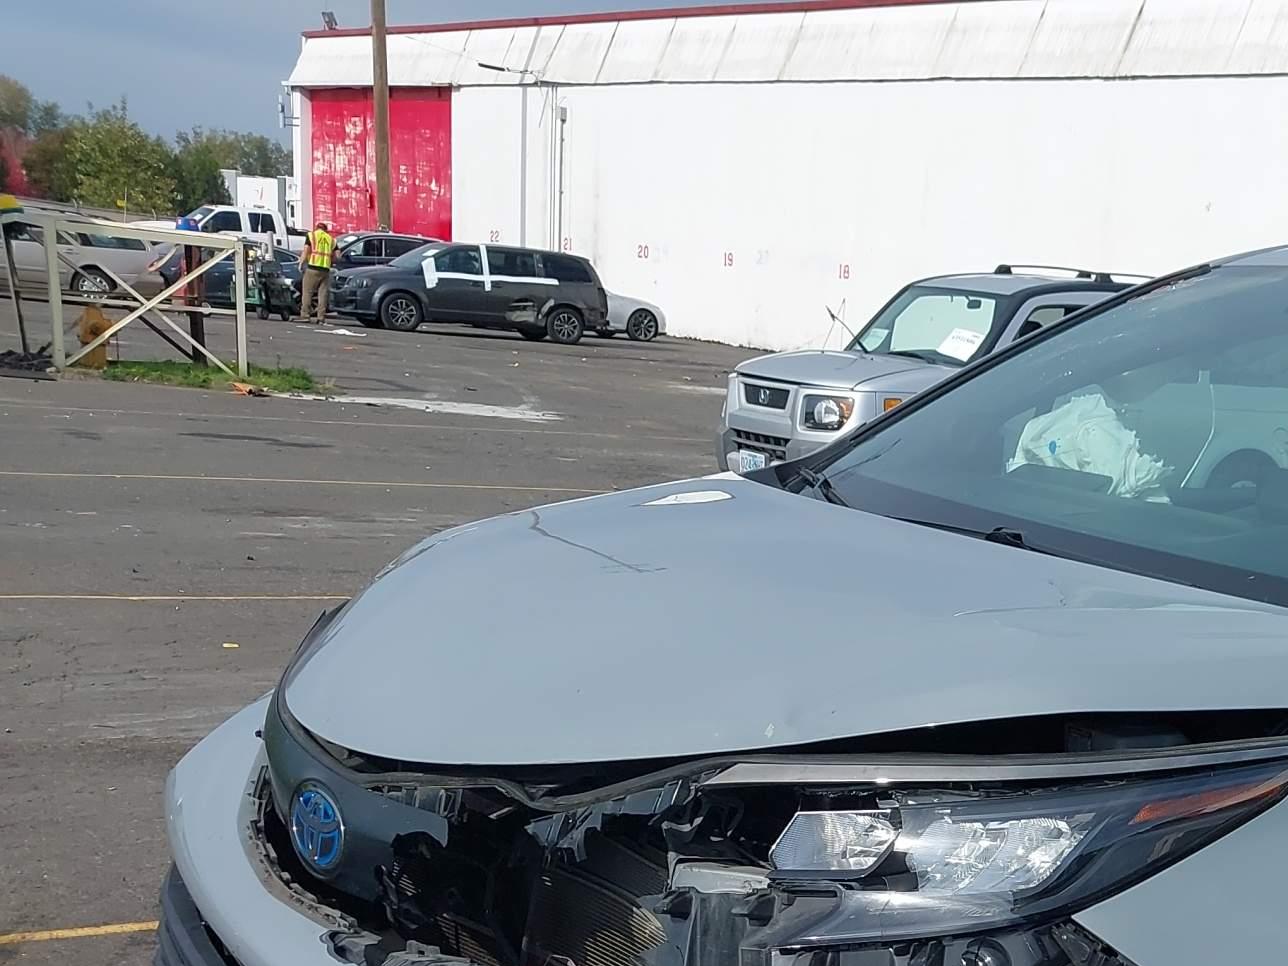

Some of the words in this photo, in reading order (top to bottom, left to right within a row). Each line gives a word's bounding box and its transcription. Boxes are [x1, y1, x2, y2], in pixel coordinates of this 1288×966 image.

[489, 230, 500, 242] 22
[563, 237, 573, 251] 21
[637, 244, 649, 259] 20
[723, 252, 734, 266] 19
[838, 264, 850, 279] 18
